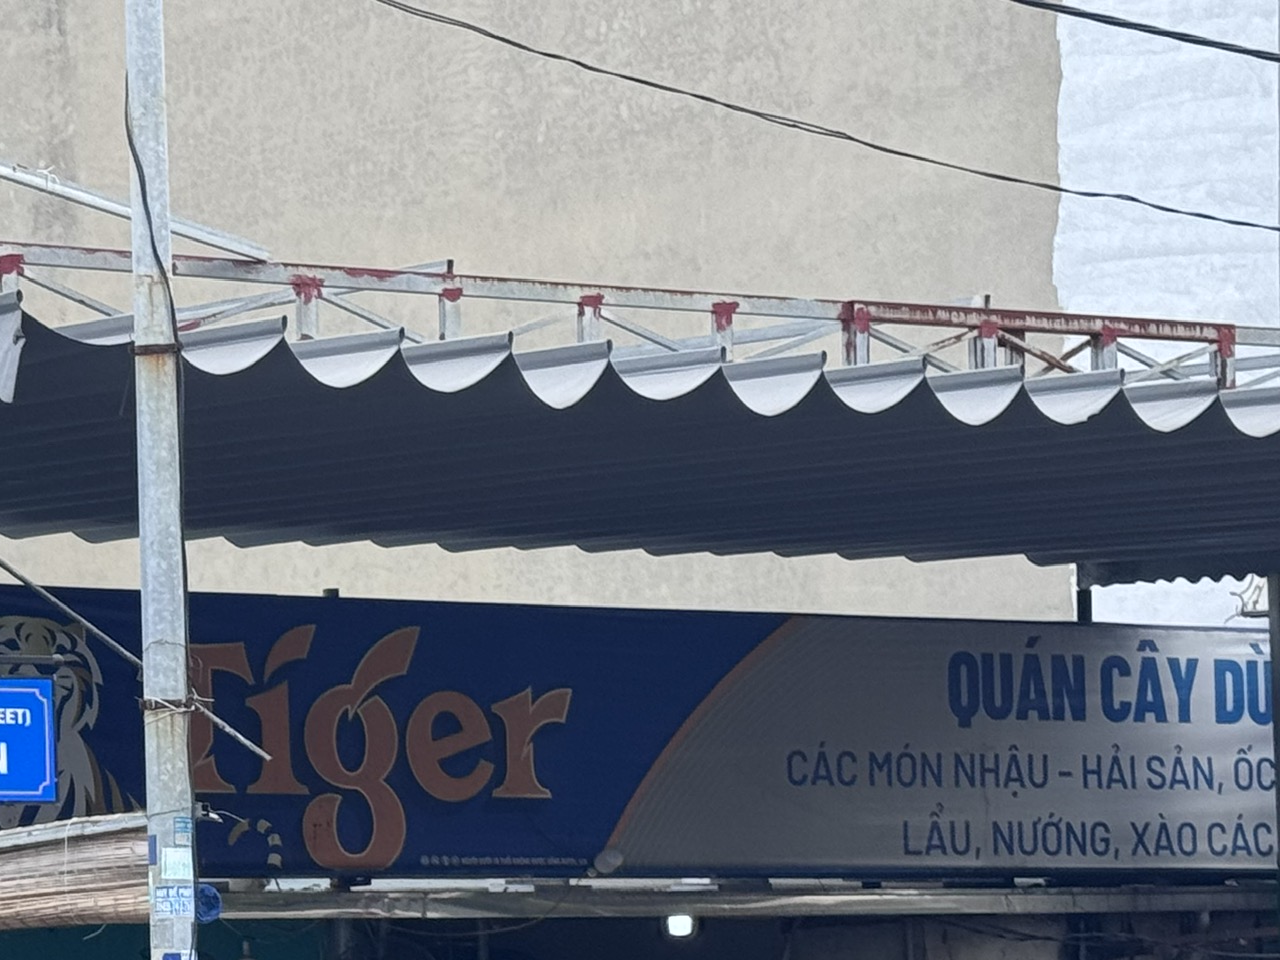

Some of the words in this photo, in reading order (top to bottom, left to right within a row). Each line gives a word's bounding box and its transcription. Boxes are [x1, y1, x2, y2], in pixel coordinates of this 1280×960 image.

[948, 635, 1087, 728] QUÁN
[1100, 639, 1199, 724] CÂY
[189, 624, 573, 870] Tiger
[786, 740, 858, 787] CÁC
[868, 742, 942, 788] MÓN
[954, 744, 1049, 798] NHẬU
[1081, 743, 1137, 790] HẢI
[1146, 744, 1224, 795] SẢN,
[1233, 744, 1276, 791] ỐC
[902, 802, 981, 861] LẨU,
[991, 811, 1120, 861] NƯỚNG,
[1130, 812, 1198, 858] XÀO
[1207, 813, 1274, 858] CÁC
